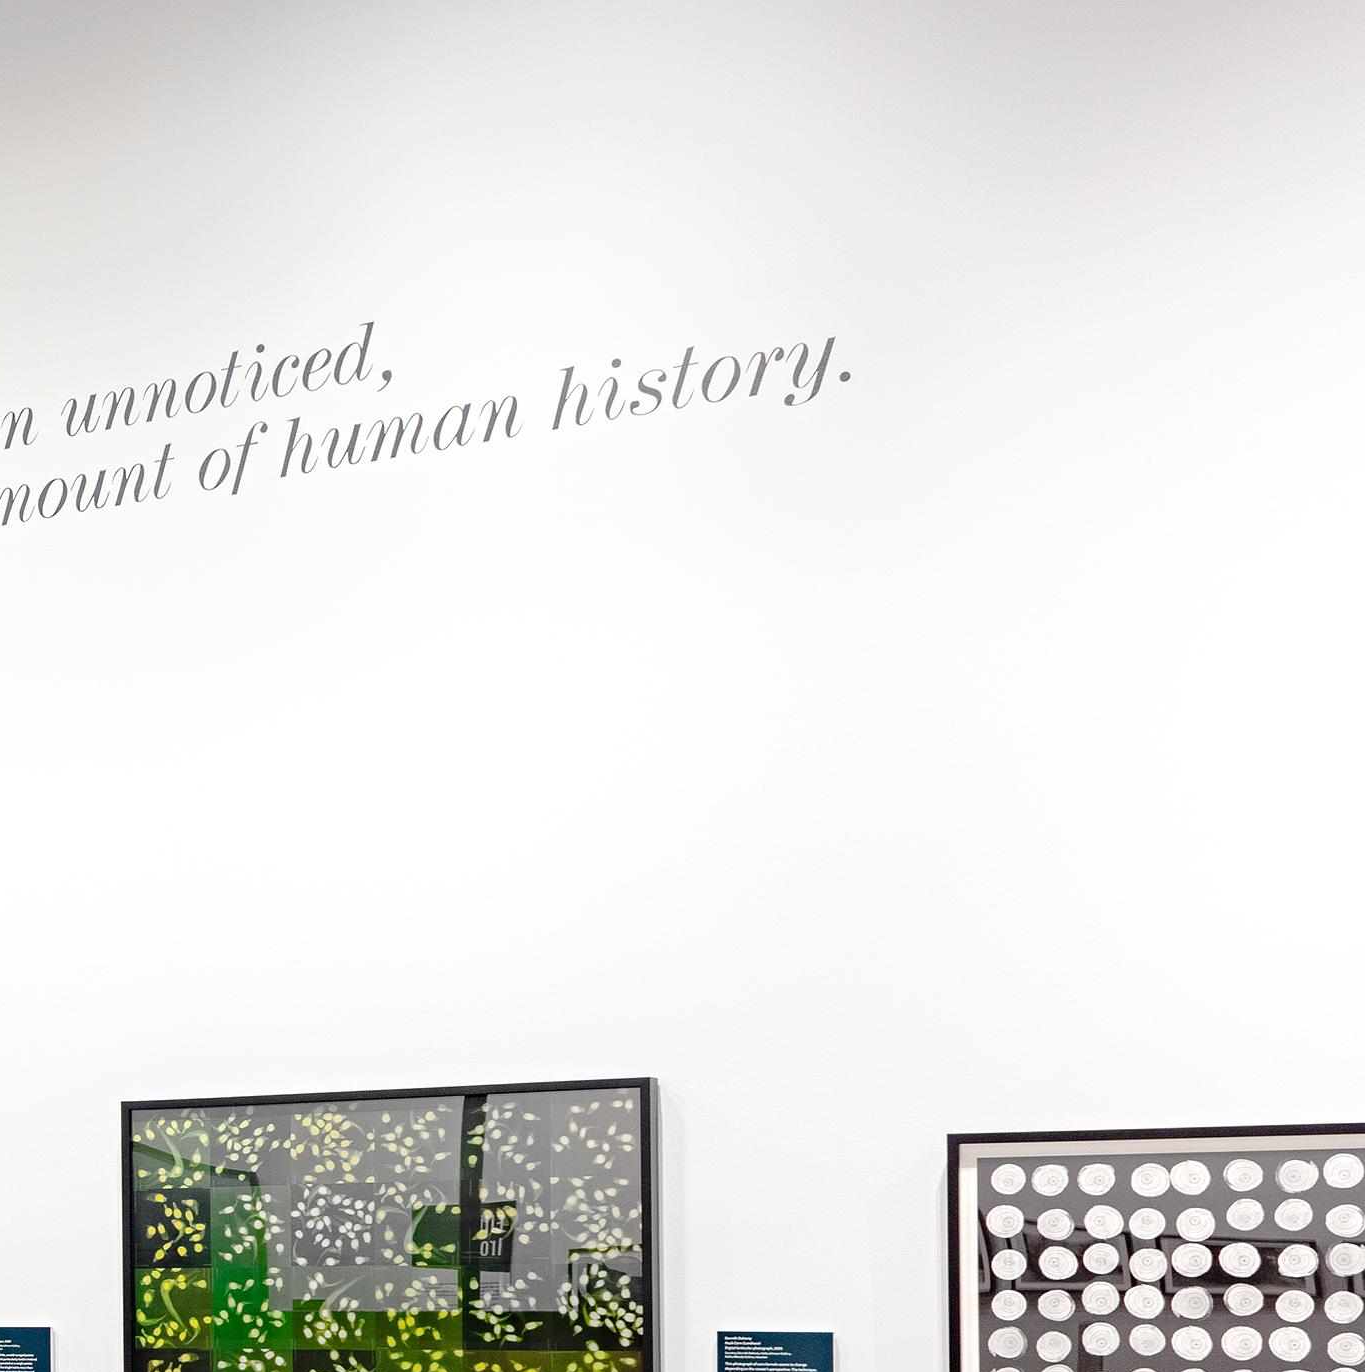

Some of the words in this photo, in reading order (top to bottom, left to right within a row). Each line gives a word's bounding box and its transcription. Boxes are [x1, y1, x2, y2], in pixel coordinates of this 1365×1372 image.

[61, 321, 395, 438] unnoticed,
[198, 420, 269, 496] of
[279, 394, 521, 478] human
[551, 337, 852, 431] history.
